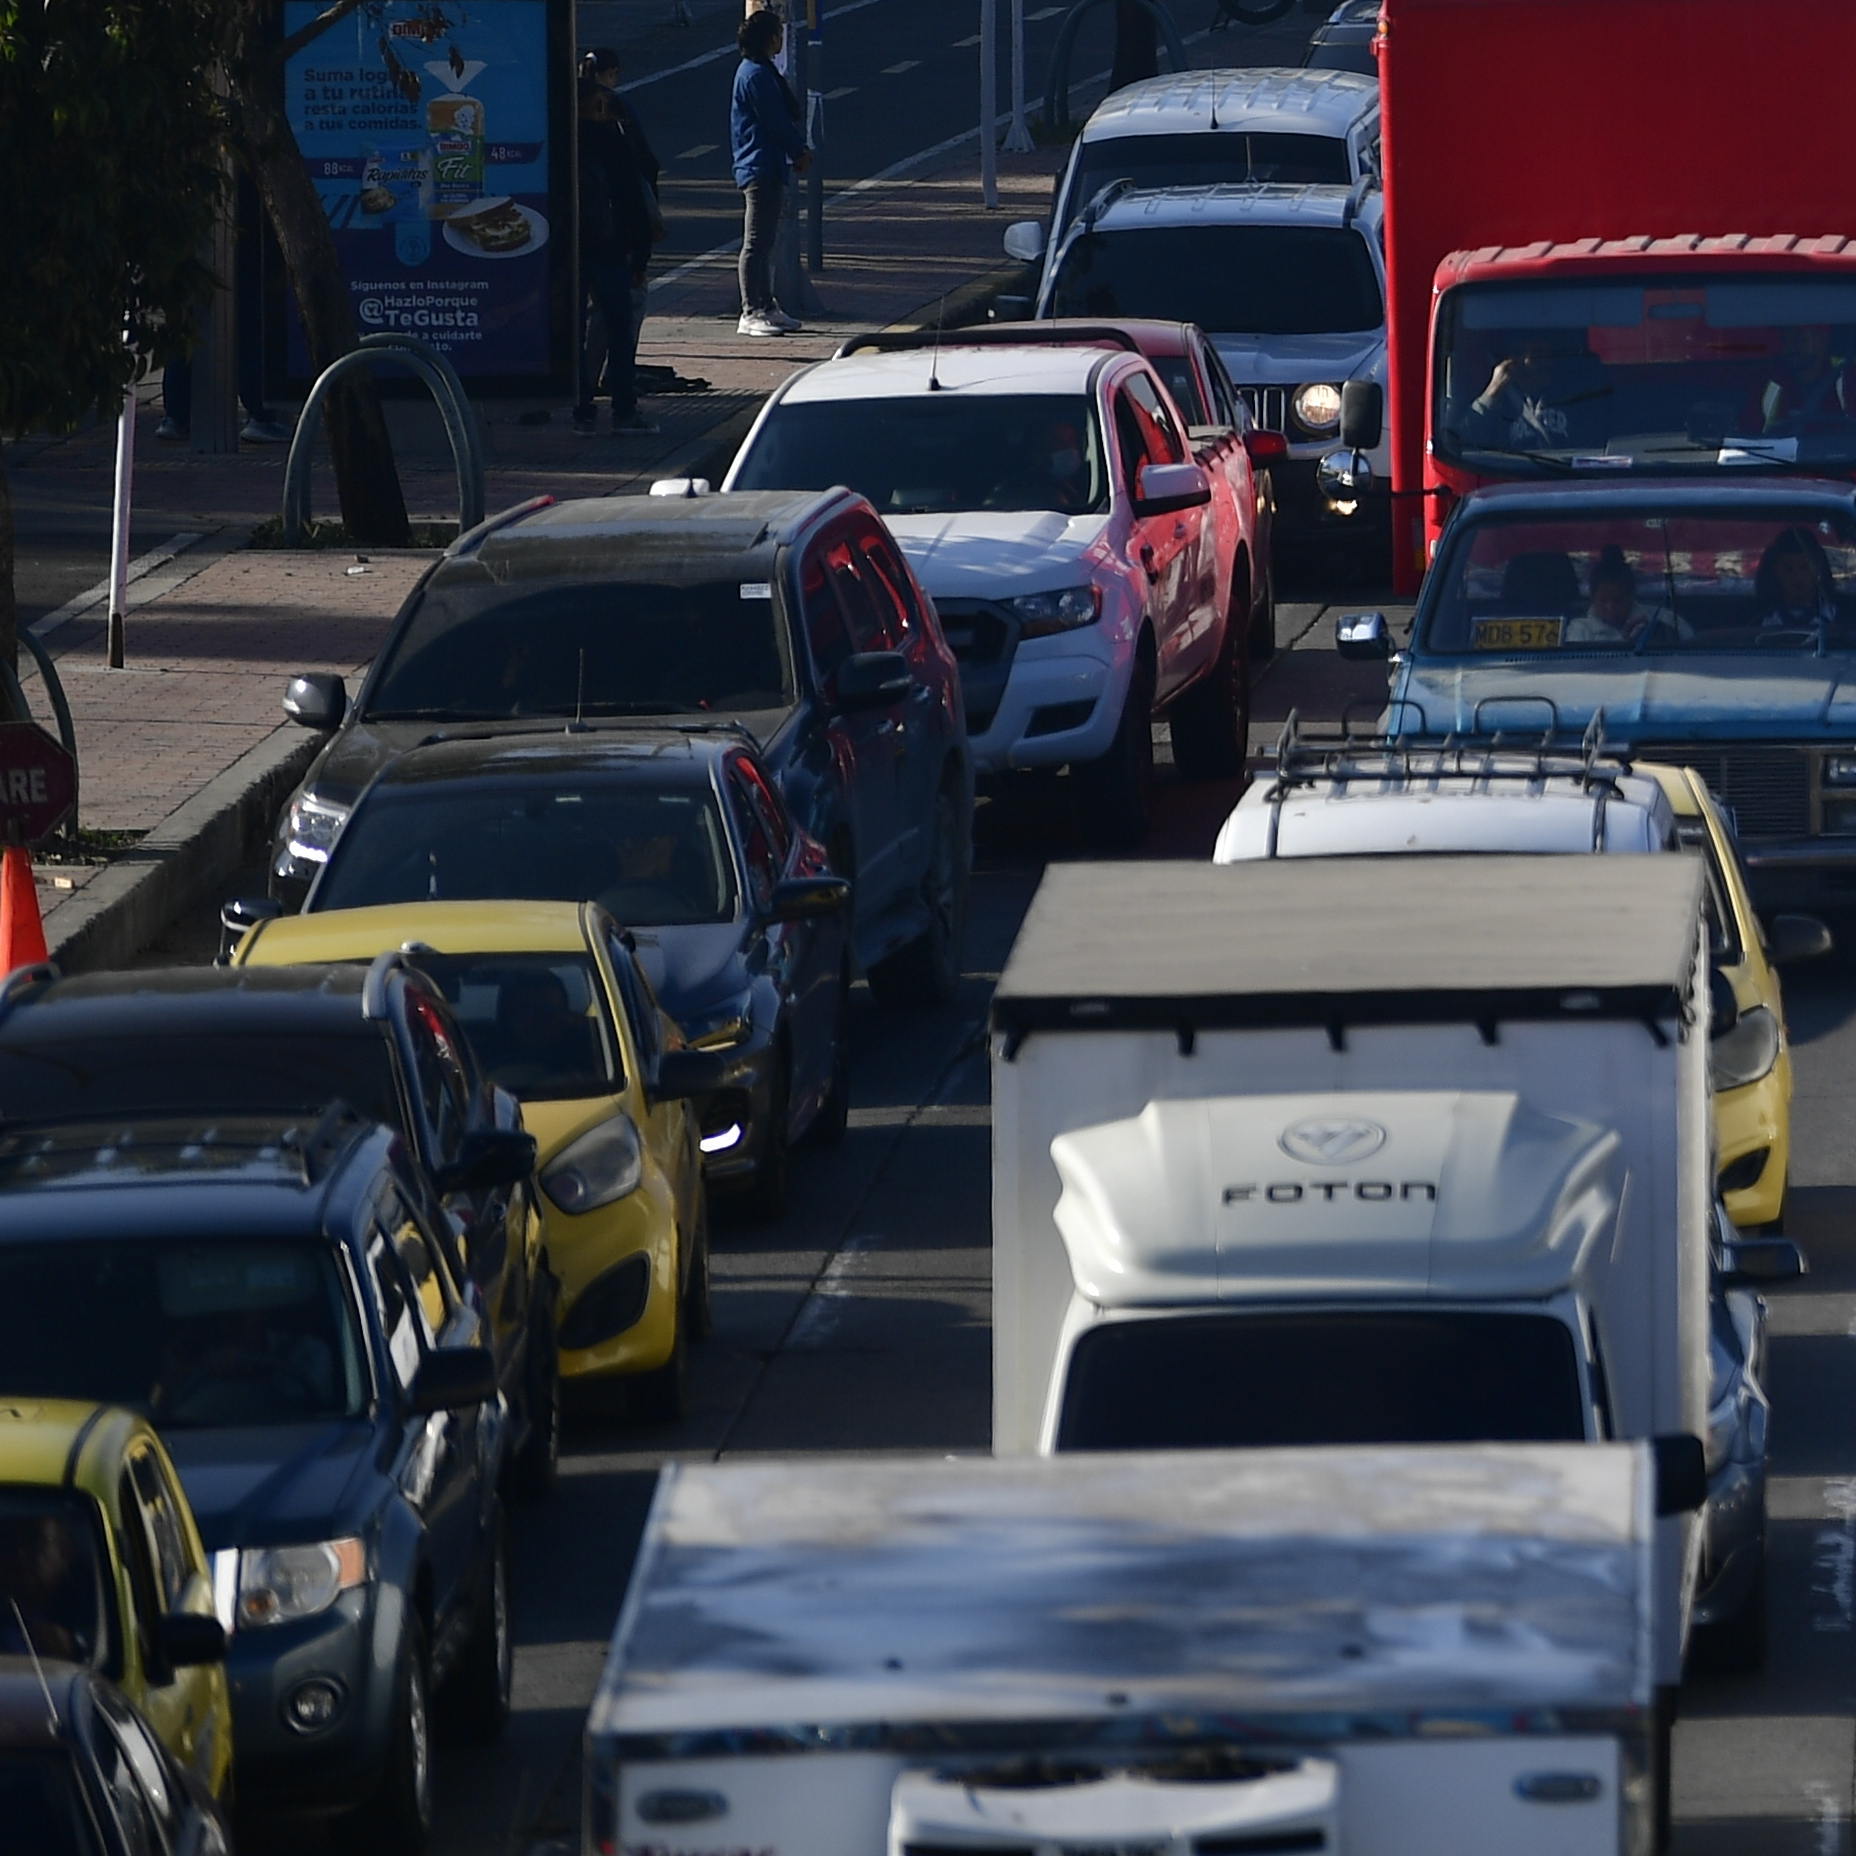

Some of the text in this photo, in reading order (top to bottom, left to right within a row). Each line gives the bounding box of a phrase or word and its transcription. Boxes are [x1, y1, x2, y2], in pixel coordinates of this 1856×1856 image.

[304, 69, 354, 82] Suma
[305, 85, 404, 100] a tu rutin
[305, 104, 346, 115] resta
[305, 118, 422, 131] a tus comidas.
[491, 146, 506, 160] 48
[324, 162, 338, 175] 88
[437, 156, 473, 180] Fit
[427, 281, 489, 292] Instagram
[384, 309, 479, 327] TeGusta
[1222, 1180, 1438, 1208] FOTON
